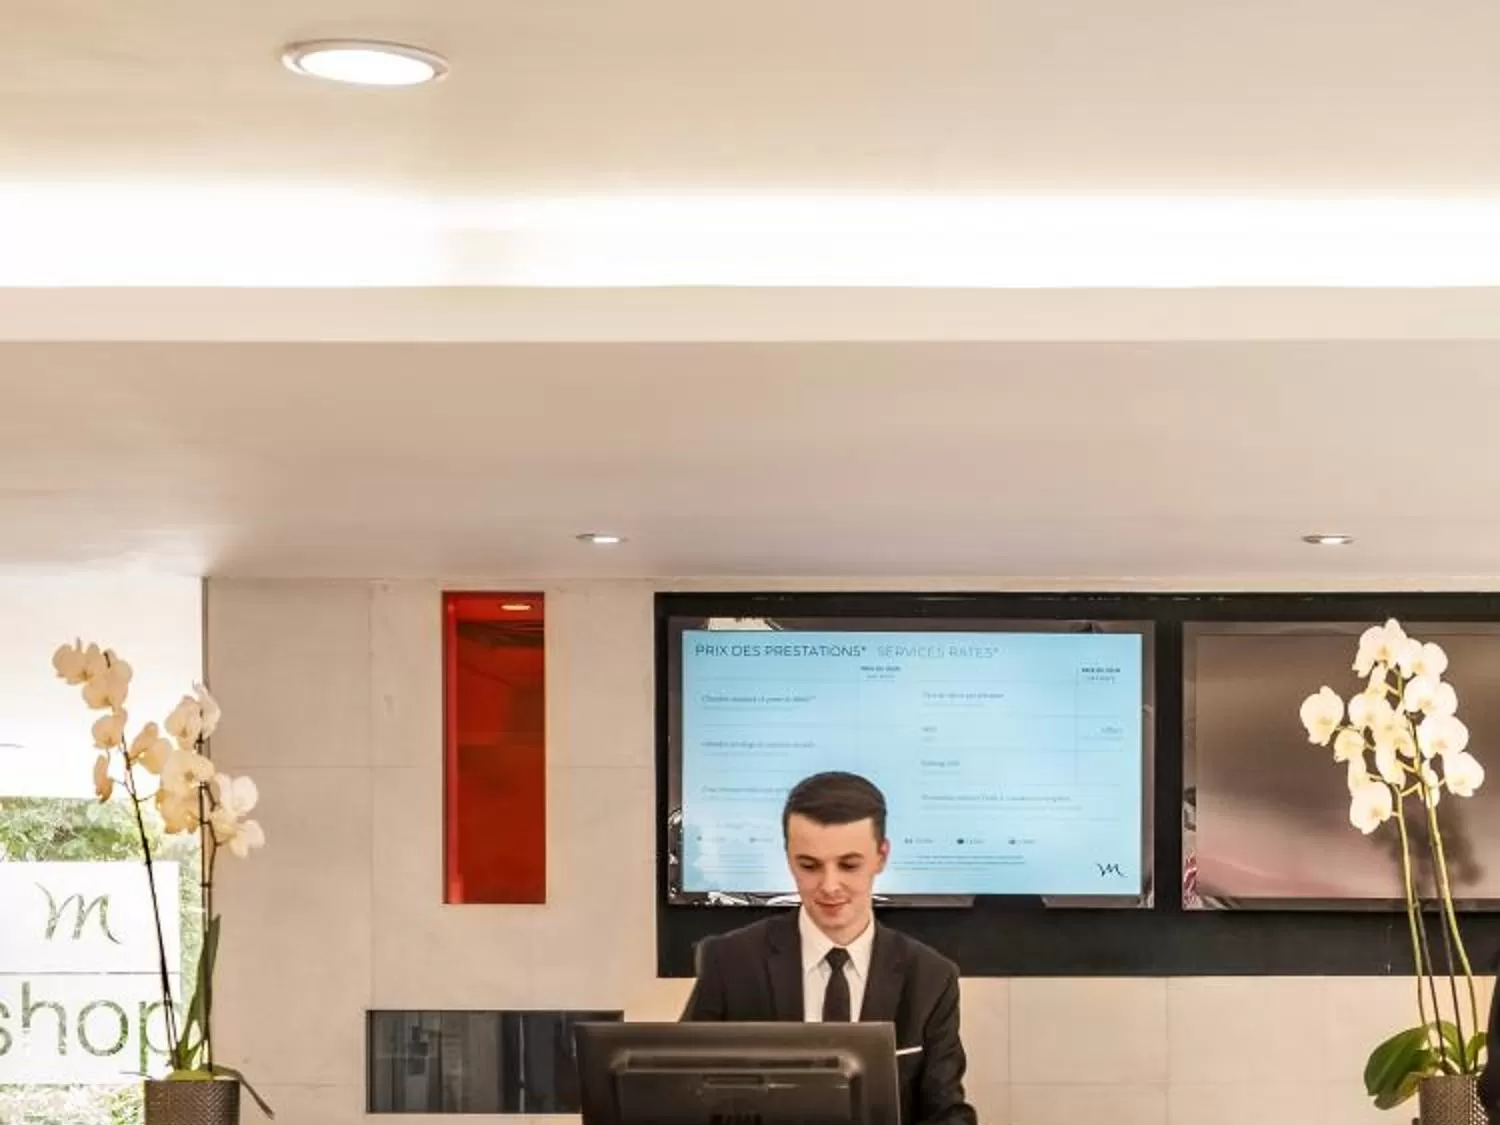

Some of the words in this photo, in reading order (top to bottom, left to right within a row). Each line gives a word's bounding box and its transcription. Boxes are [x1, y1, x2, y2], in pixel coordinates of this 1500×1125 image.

[695, 644, 728, 657] PRIX
[731, 644, 761, 657] DES
[877, 645, 944, 658] SERVICES
